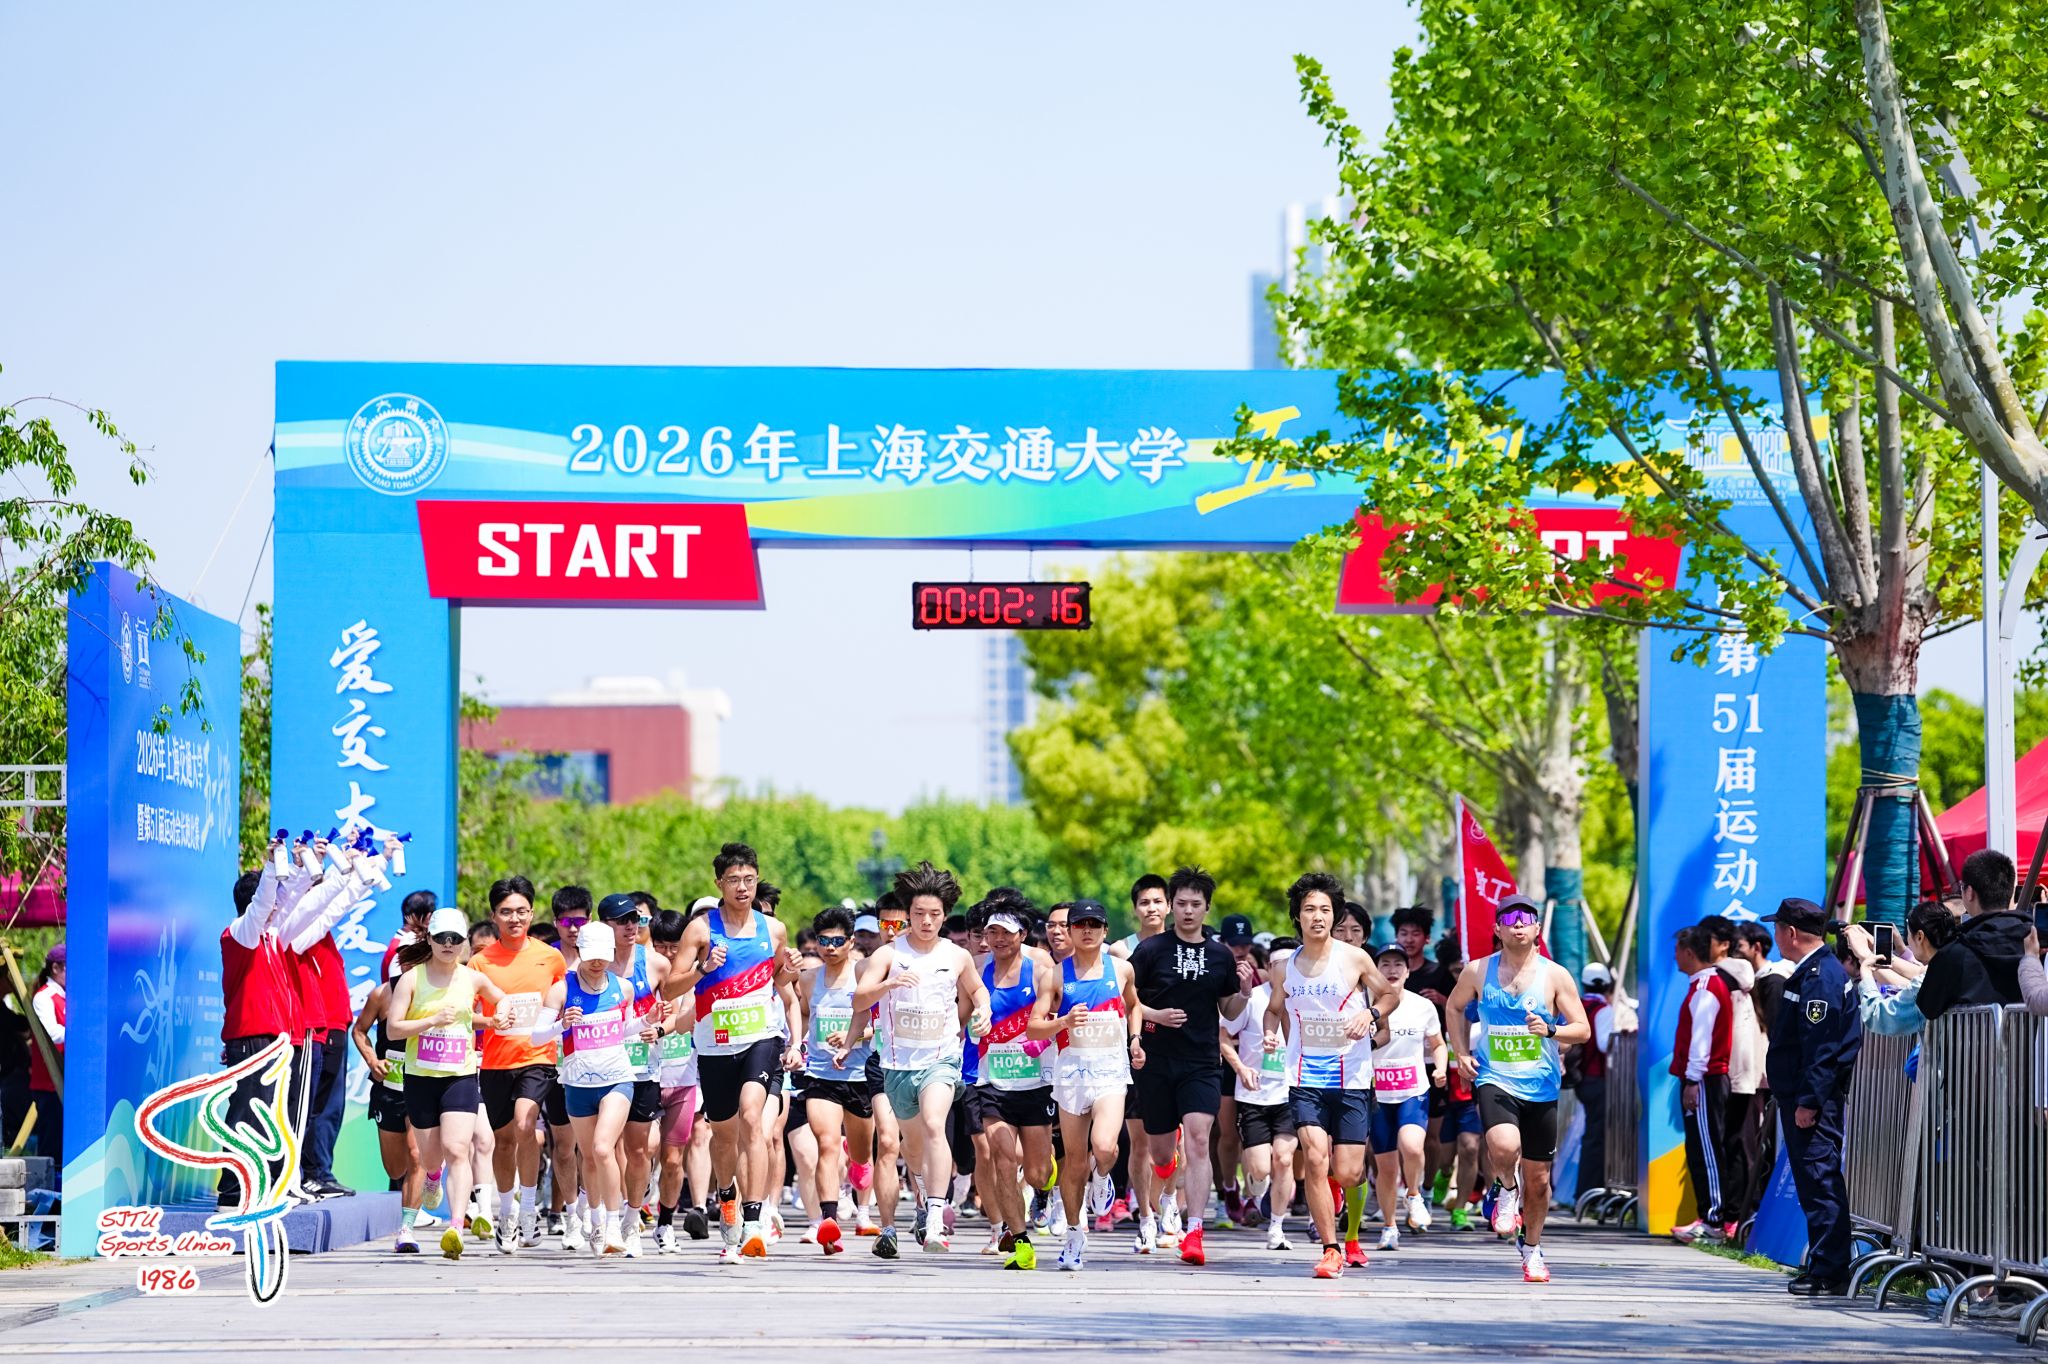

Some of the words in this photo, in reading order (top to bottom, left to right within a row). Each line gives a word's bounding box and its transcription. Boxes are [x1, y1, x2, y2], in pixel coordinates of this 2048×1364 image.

[569, 422, 1186, 485] 2026年上海交通大学
[477, 523, 701, 579] START
[920, 587, 1082, 624] 00:02:16
[136, 729, 203, 792] 2026年上海交通大学
[516, 1005, 537, 1018] 27
[718, 1010, 759, 1026] K039
[820, 1021, 848, 1032] H07
[900, 1016, 939, 1029] G080
[577, 1022, 620, 1040] M014
[1073, 1026, 1114, 1038] G074
[1304, 1024, 1345, 1037] G025
[421, 1039, 462, 1053] M011
[626, 1045, 643, 1057] 45
[1493, 1038, 1536, 1052] K012
[993, 1055, 1034, 1068] H041
[1376, 1069, 1412, 1082] N015
